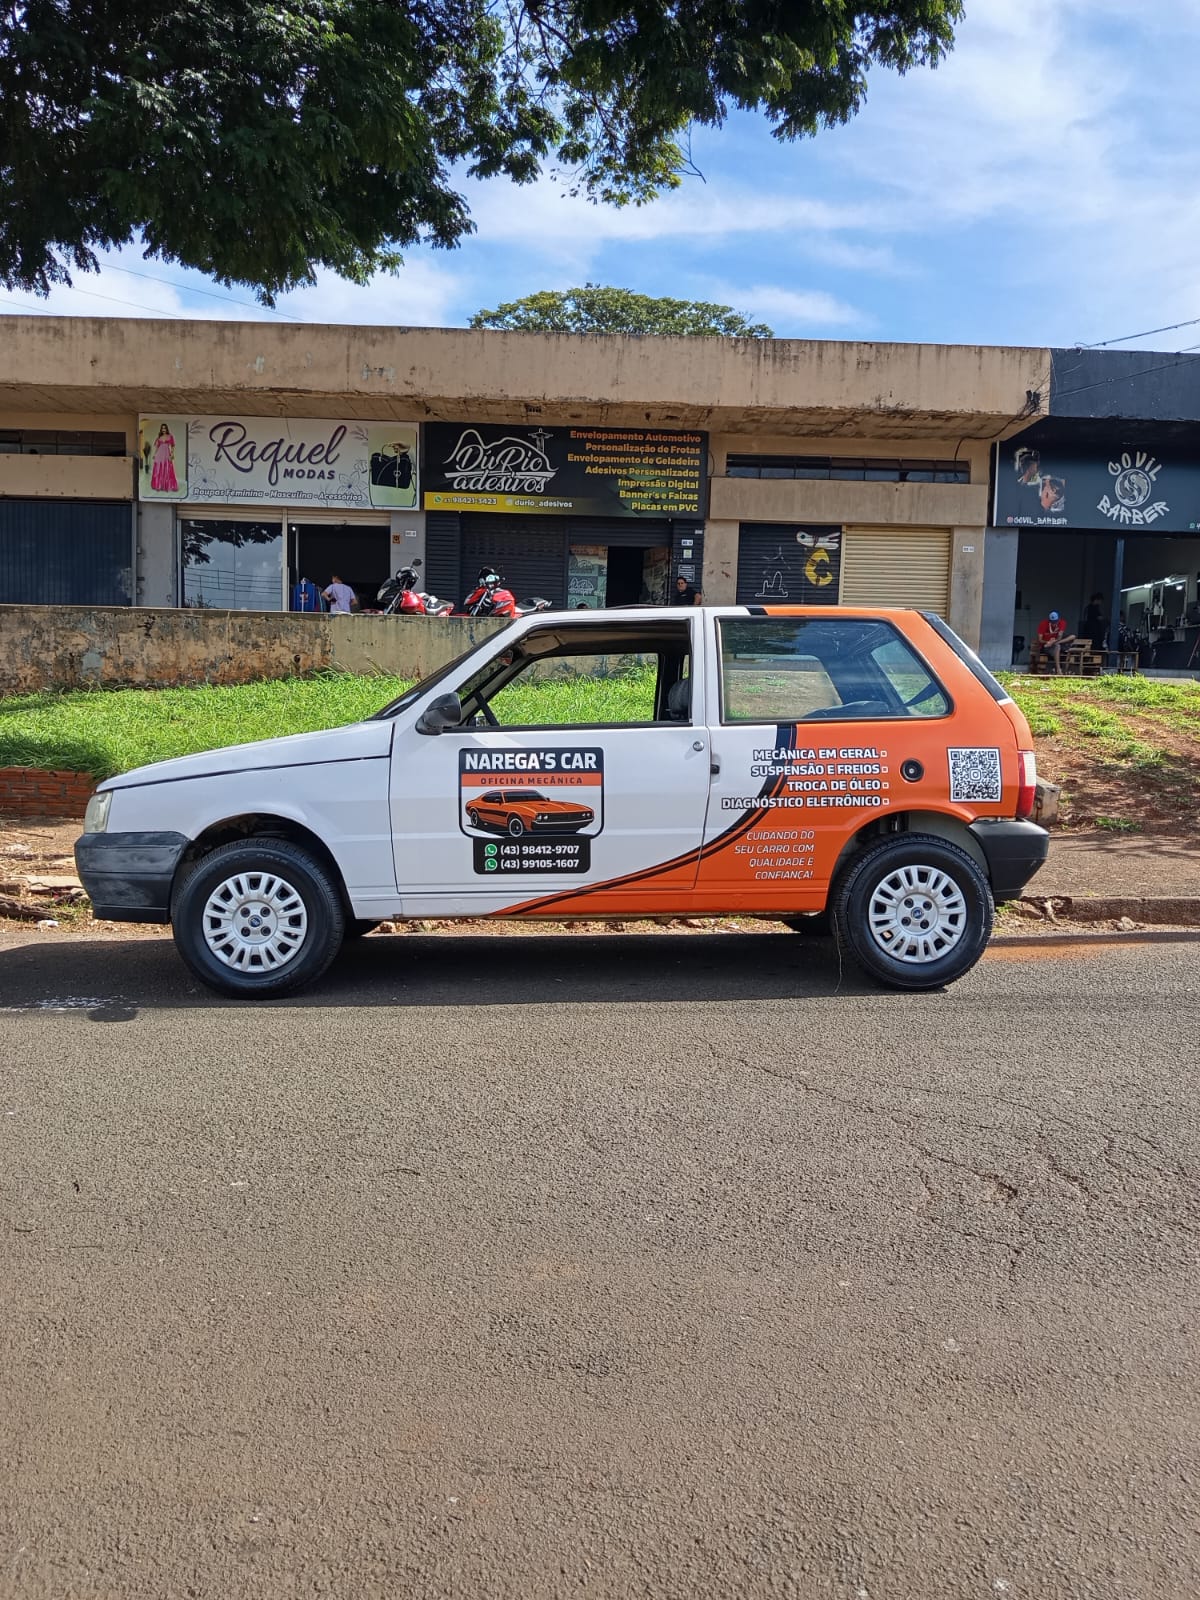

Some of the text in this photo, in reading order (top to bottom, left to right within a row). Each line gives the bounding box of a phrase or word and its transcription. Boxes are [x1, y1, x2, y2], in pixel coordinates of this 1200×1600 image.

[570, 430, 702, 443] Envelopamento Automotivo
[209, 421, 347, 486] Raquel
[585, 442, 701, 454] Personalização de Frotas
[567, 453, 700, 466] Envelopamento de Geladeira
[283, 468, 336, 480] MODAS
[585, 466, 700, 478] Adesivos Personalizados
[453, 469, 546, 493] adesivos
[618, 478, 699, 490] Impressão Digital
[193, 488, 224, 496] Roupas
[226, 488, 264, 498] Feminina
[270, 490, 312, 499] Masculina
[318, 492, 362, 502] Acessórios
[668, 491, 698, 500] Faixas
[632, 502, 662, 511] Placas
[678, 503, 698, 512] PVC
[1097, 494, 1170, 524] BARBER
[753, 748, 880, 760] MECÂNICA EM GERAL
[465, 752, 597, 770] NAREGA'S CAR
[751, 764, 880, 776] SUSPENSÃO E FREIOS
[480, 775, 583, 785] OFICINA MECÂNICA
[787, 777, 881, 792] TROCA DE ÓLEO
[722, 794, 881, 810] DIAGNÓSTICO ELETRÔNICO
[746, 830, 815, 840] CUIDANDO DO
[500, 845, 580, 855] (43) 98412-9707
[734, 844, 814, 854] SEU CARRO COM
[500, 859, 580, 869] (43) 99105-1607
[749, 857, 814, 868] QUALIDADE E
[755, 870, 813, 880] CONFIANÇA!
